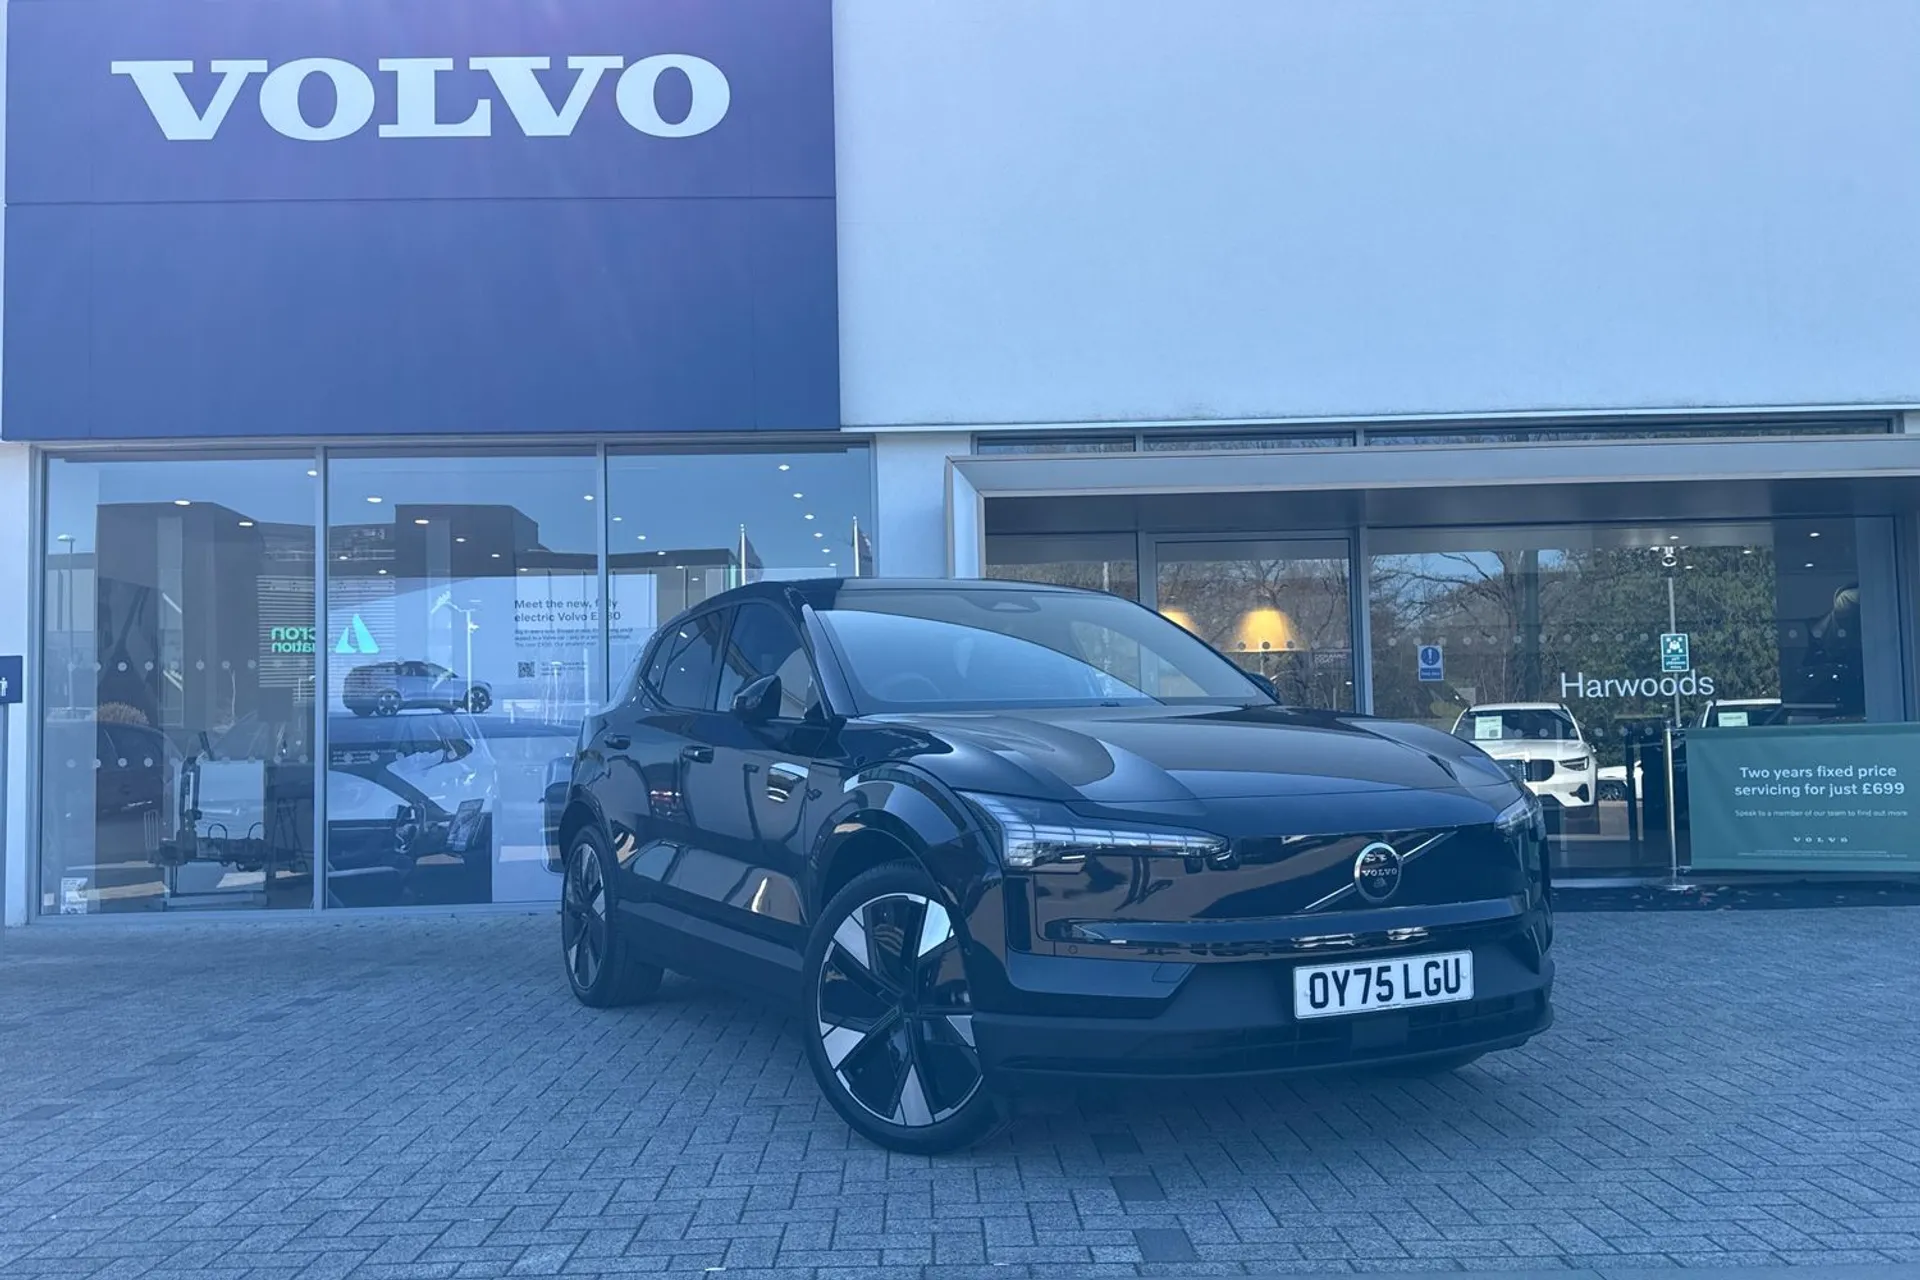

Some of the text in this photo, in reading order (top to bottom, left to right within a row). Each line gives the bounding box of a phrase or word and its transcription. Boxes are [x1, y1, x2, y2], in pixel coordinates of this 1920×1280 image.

[111, 53, 731, 142] VOLVO
[514, 600, 543, 609] Meet
[546, 600, 564, 609] the
[514, 611, 555, 622] electric
[557, 611, 588, 621] Volvo
[1561, 669, 1715, 698] Harwoods
[1739, 765, 1897, 780] Two years fixed price
[1735, 782, 1905, 798] servicing for just £699
[1361, 867, 1398, 877] VOLVO
[1309, 957, 1461, 1010] OY75 LGU
